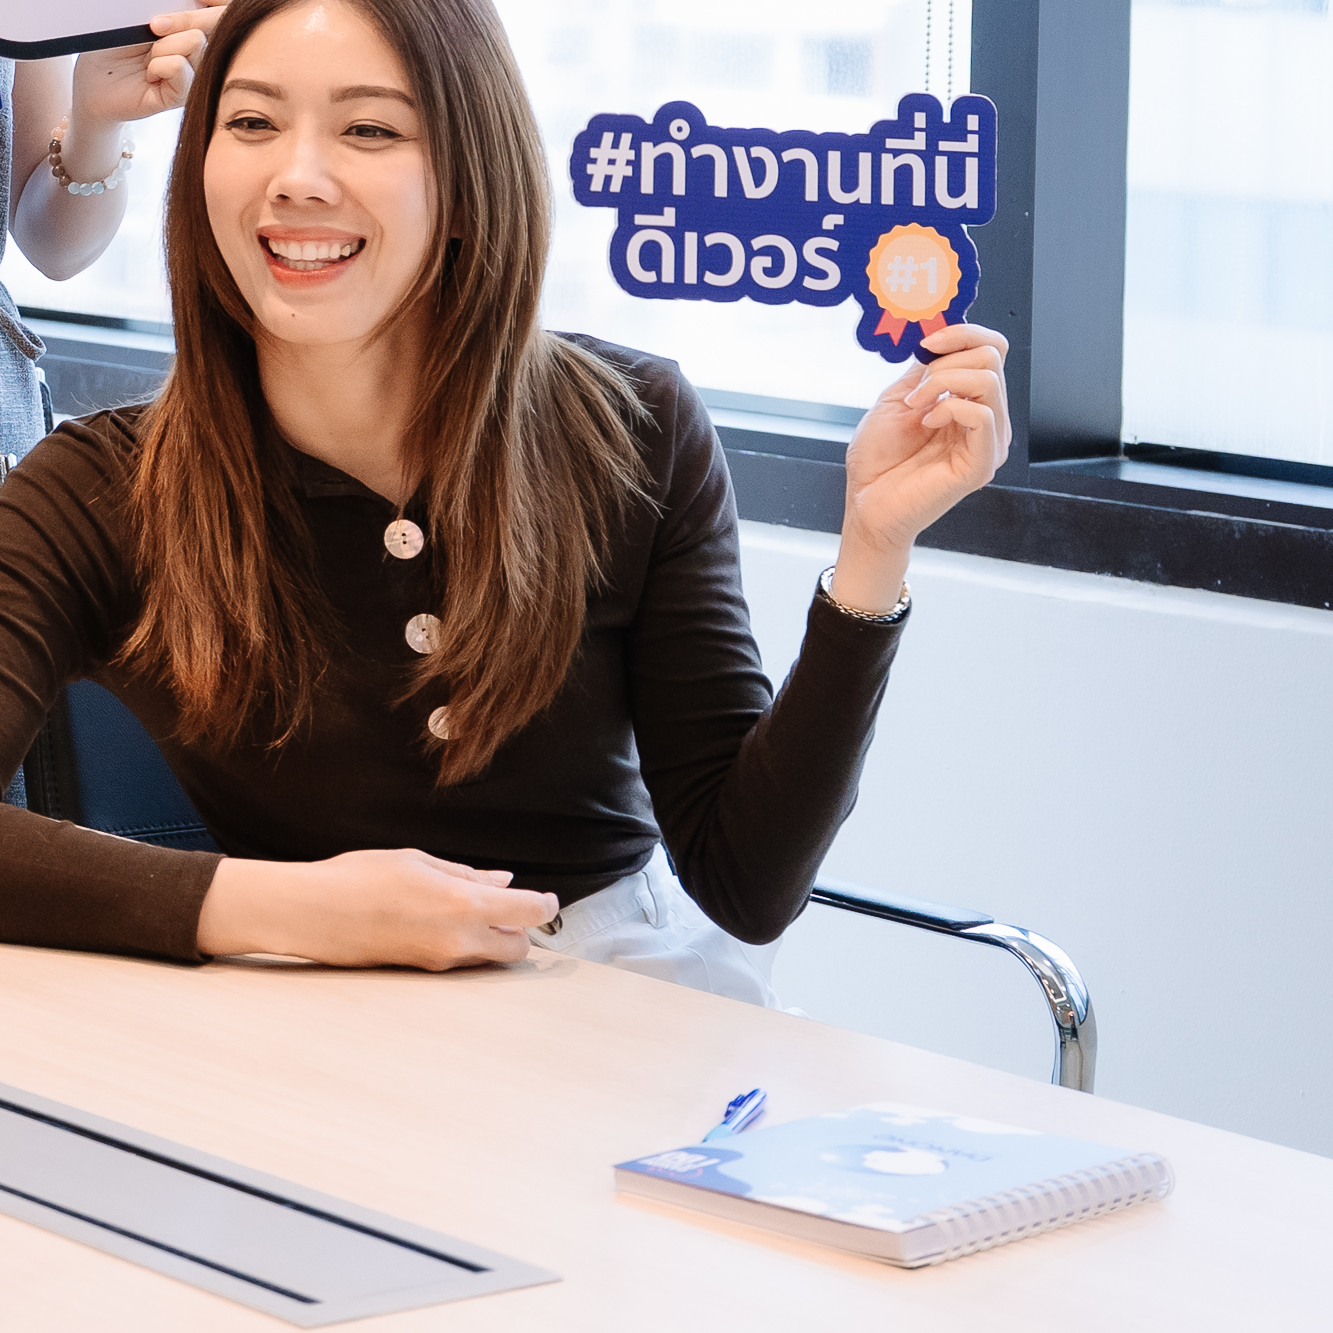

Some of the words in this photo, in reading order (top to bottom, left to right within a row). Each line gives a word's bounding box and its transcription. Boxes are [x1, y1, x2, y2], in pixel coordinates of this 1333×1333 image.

[586, 111, 979, 209] #ทำงานที่นี่
[625, 207, 845, 291] ดีเวอร์
[886, 255, 938, 293] #1
